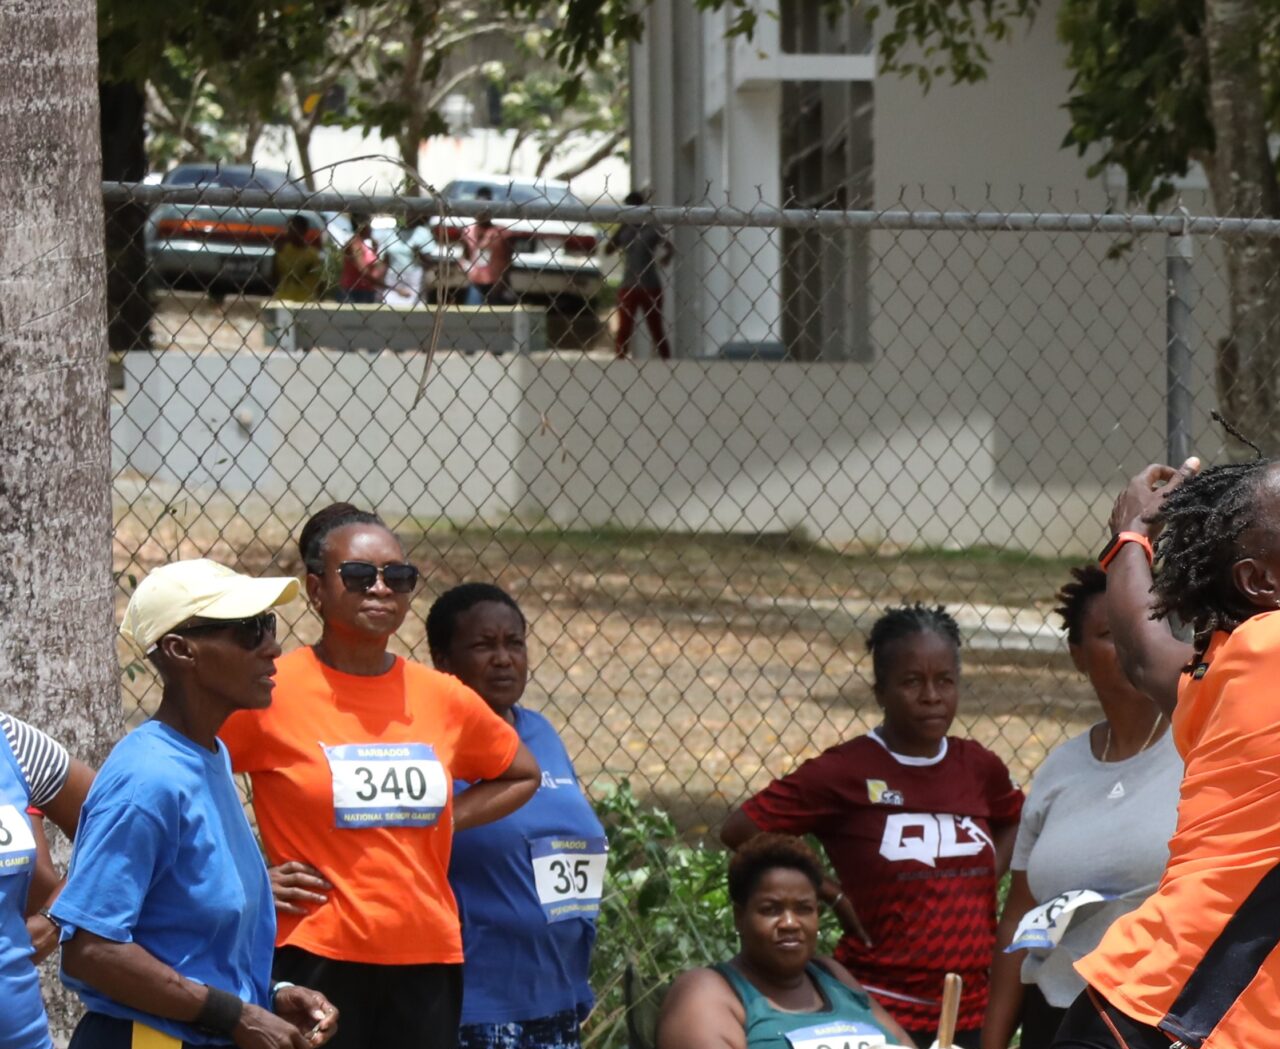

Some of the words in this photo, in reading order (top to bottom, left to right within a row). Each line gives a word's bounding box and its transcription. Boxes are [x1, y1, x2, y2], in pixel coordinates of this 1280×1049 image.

[357, 747, 411, 757] BARBADOS
[355, 766, 427, 801] 340
[344, 812, 383, 823] NATIONAL
[549, 859, 590, 895] 35
